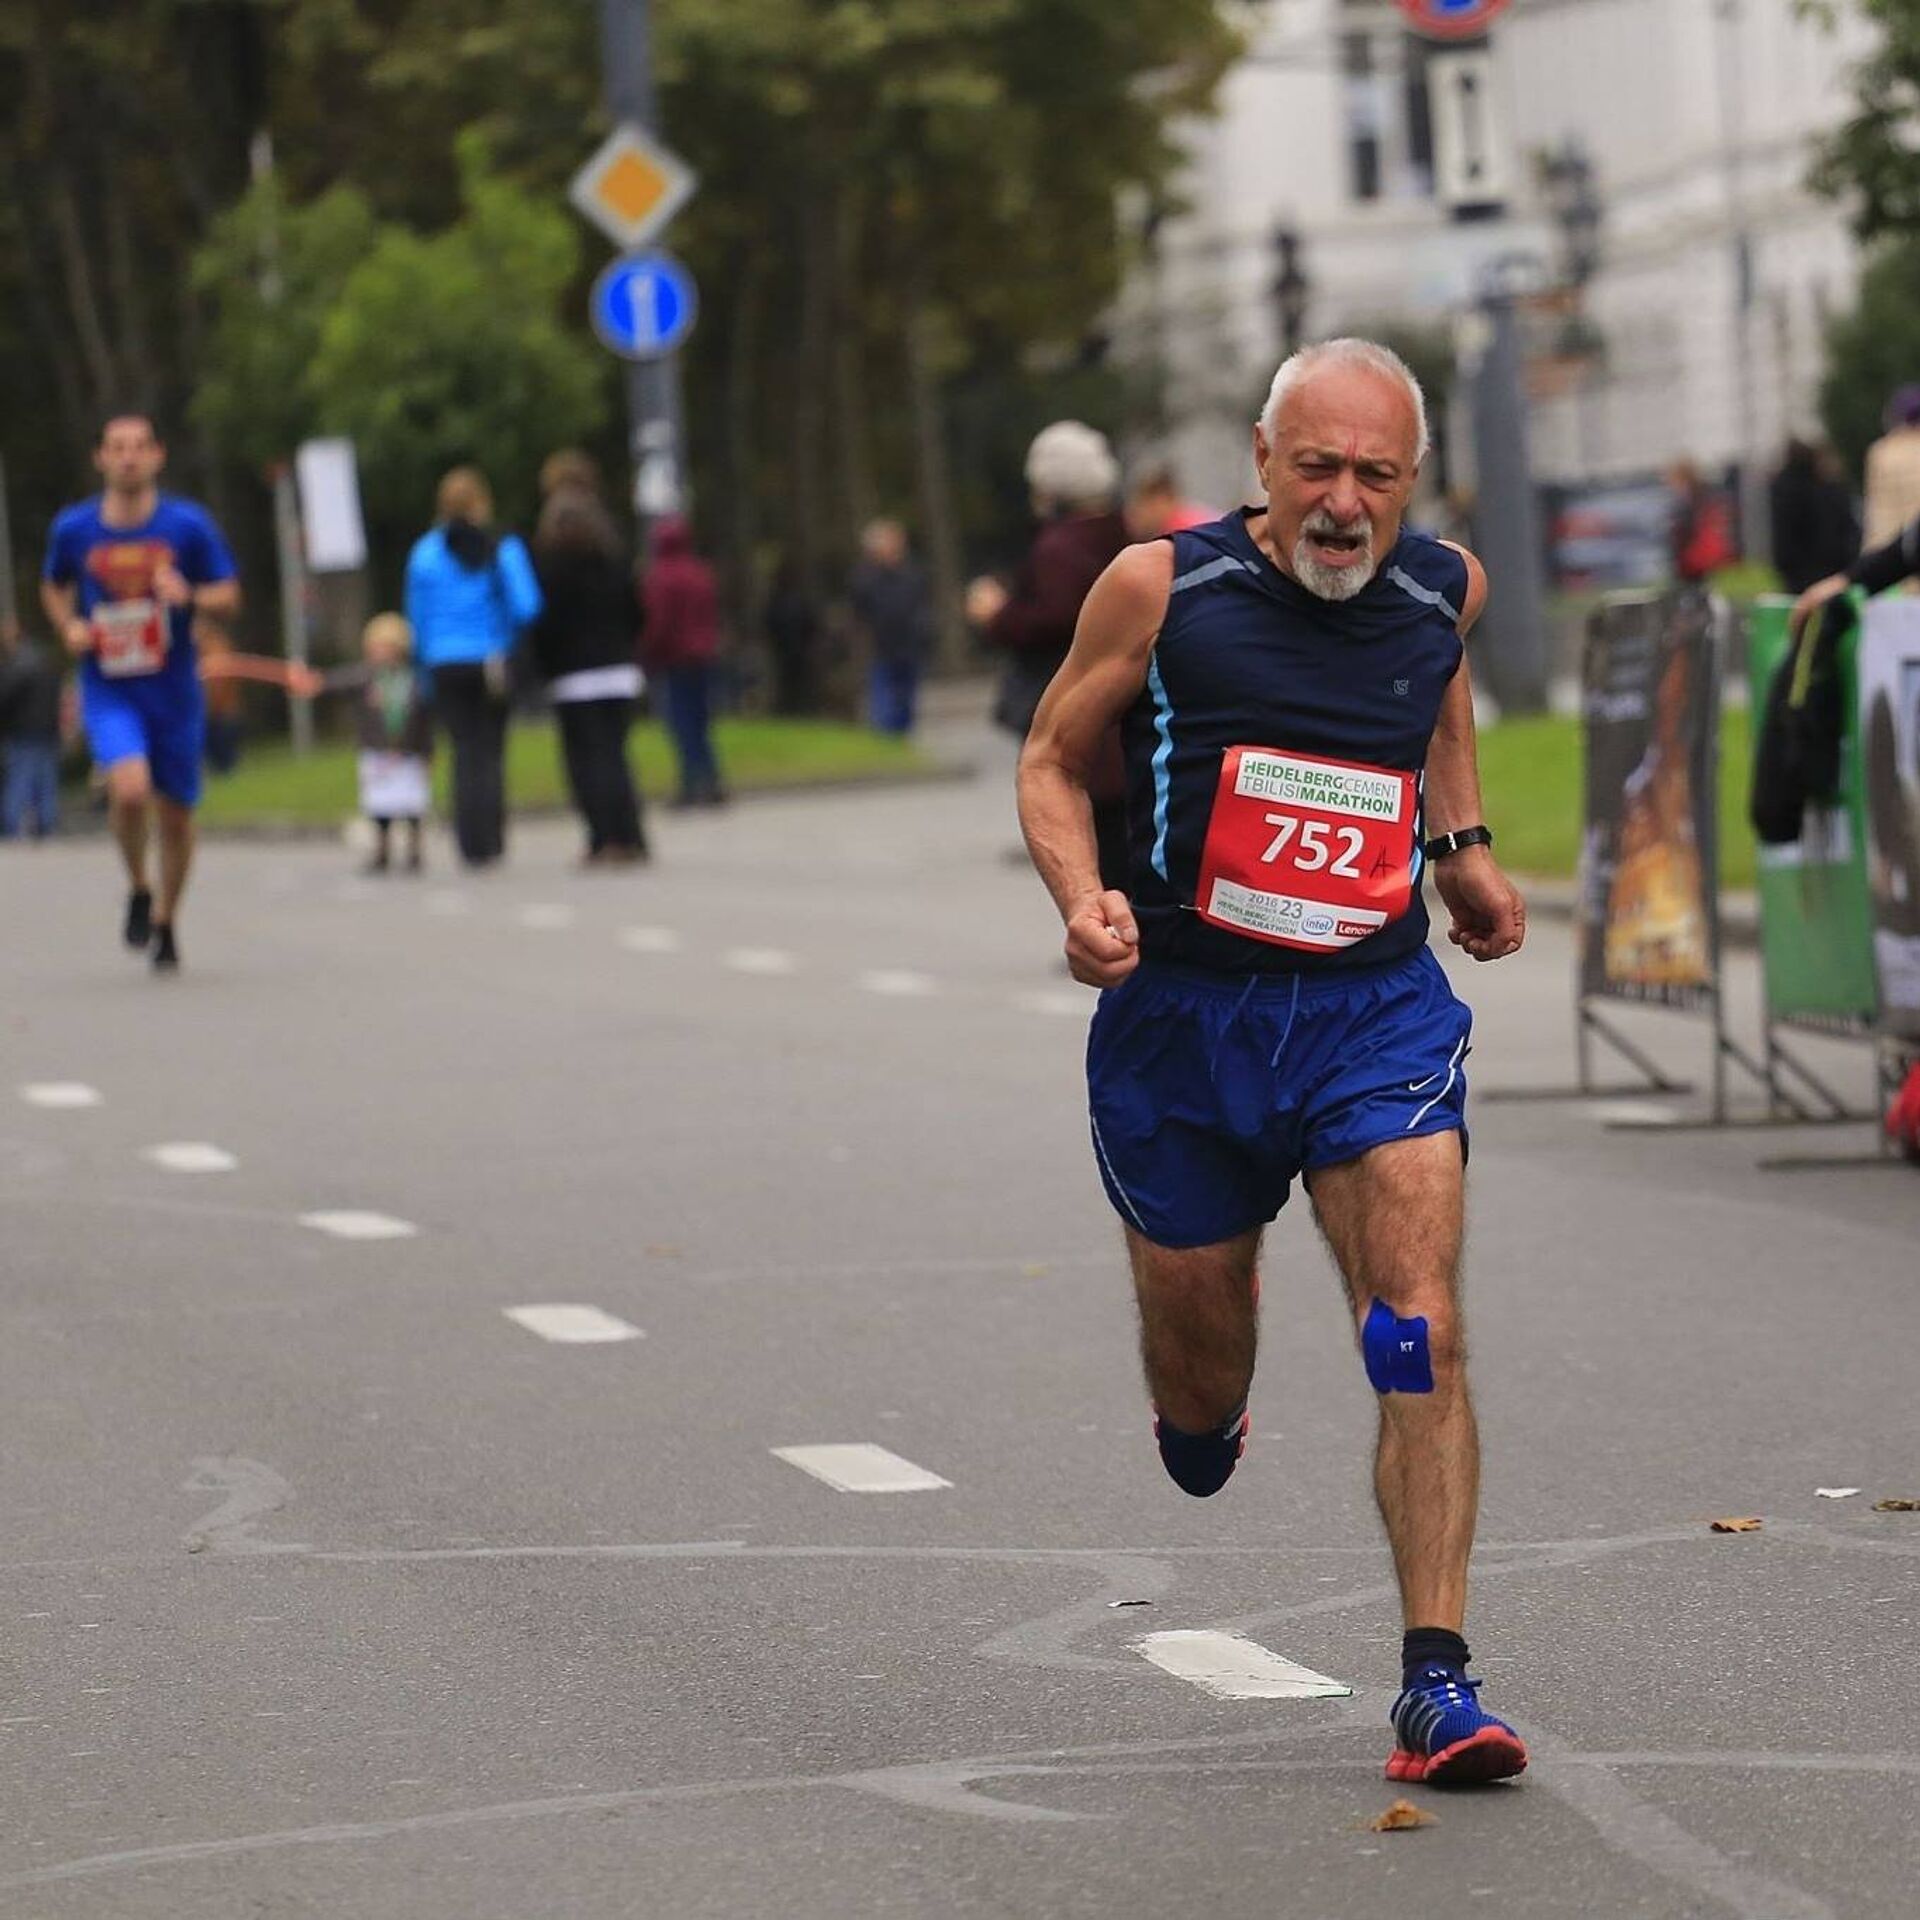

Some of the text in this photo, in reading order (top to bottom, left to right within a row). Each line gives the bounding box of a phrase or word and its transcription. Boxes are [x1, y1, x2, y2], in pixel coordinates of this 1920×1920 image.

[1243, 760, 1398, 799] HEIDELBERGCEMENT
[1243, 776, 1394, 815] TBILISIMARATHON
[1261, 812, 1365, 879] 752
[1248, 893, 1278, 907] 2016
[1279, 900, 1304, 919] 23
[1305, 917, 1330, 931] intel
[1400, 1341, 1415, 1353] KT
